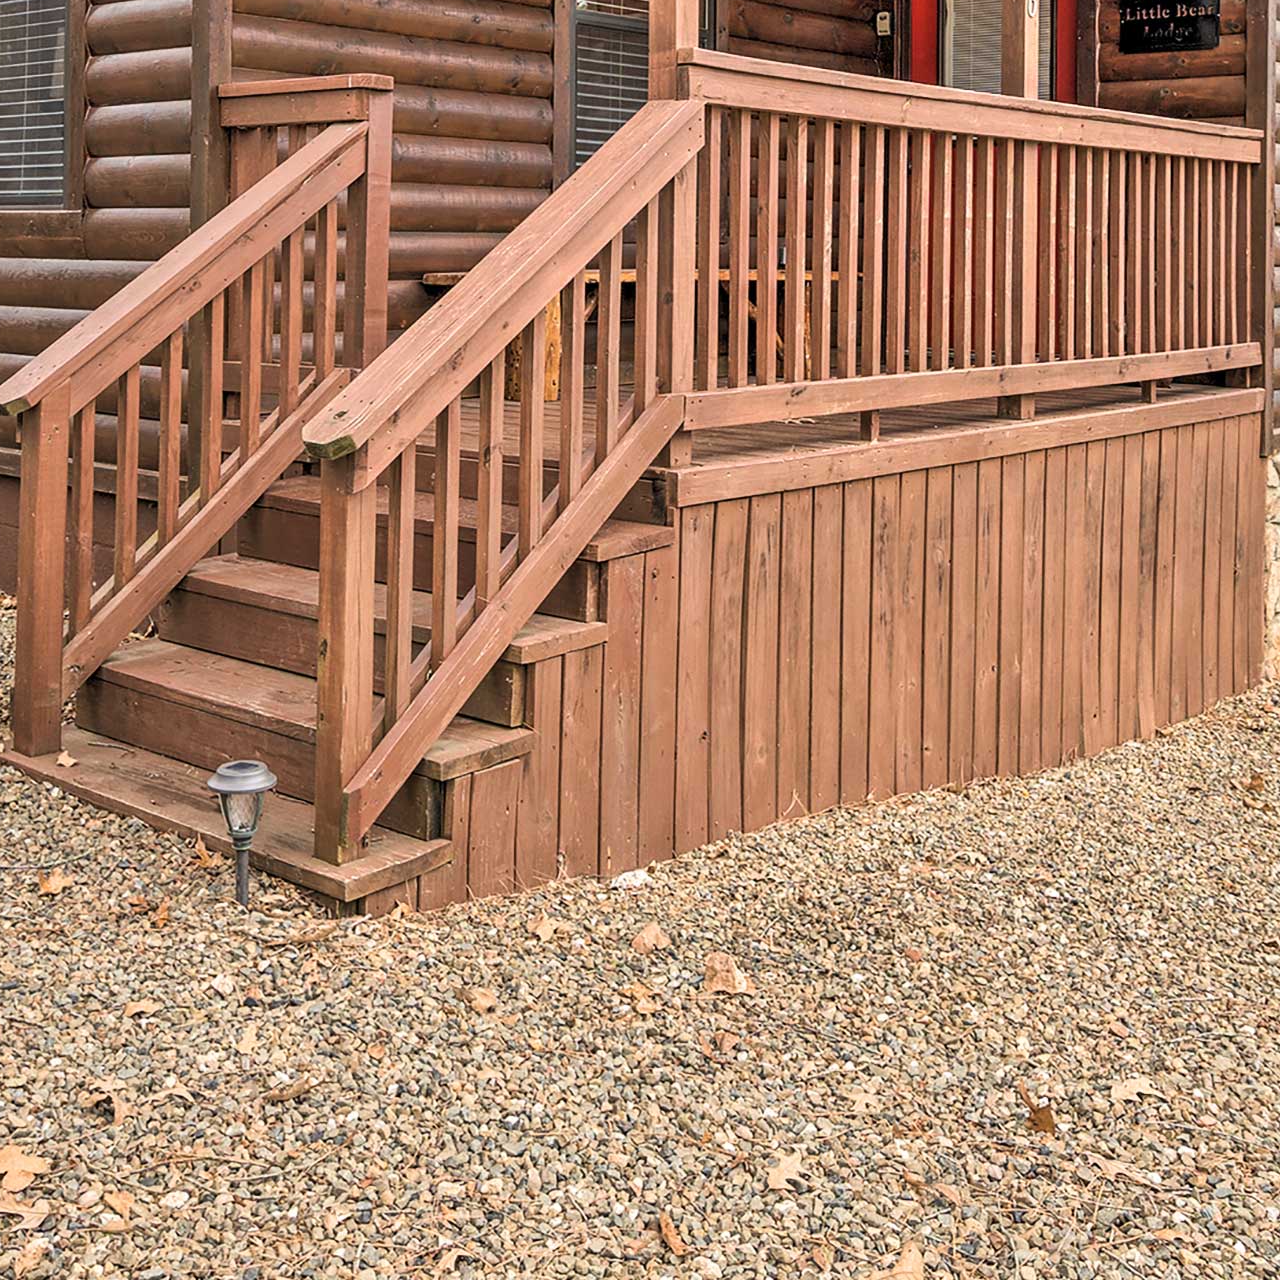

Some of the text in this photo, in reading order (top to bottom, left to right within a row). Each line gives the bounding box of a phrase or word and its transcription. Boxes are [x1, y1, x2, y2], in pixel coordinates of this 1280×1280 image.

[1125, 2, 1214, 21] Little Bear
[1143, 23, 1194, 42] Lodge
